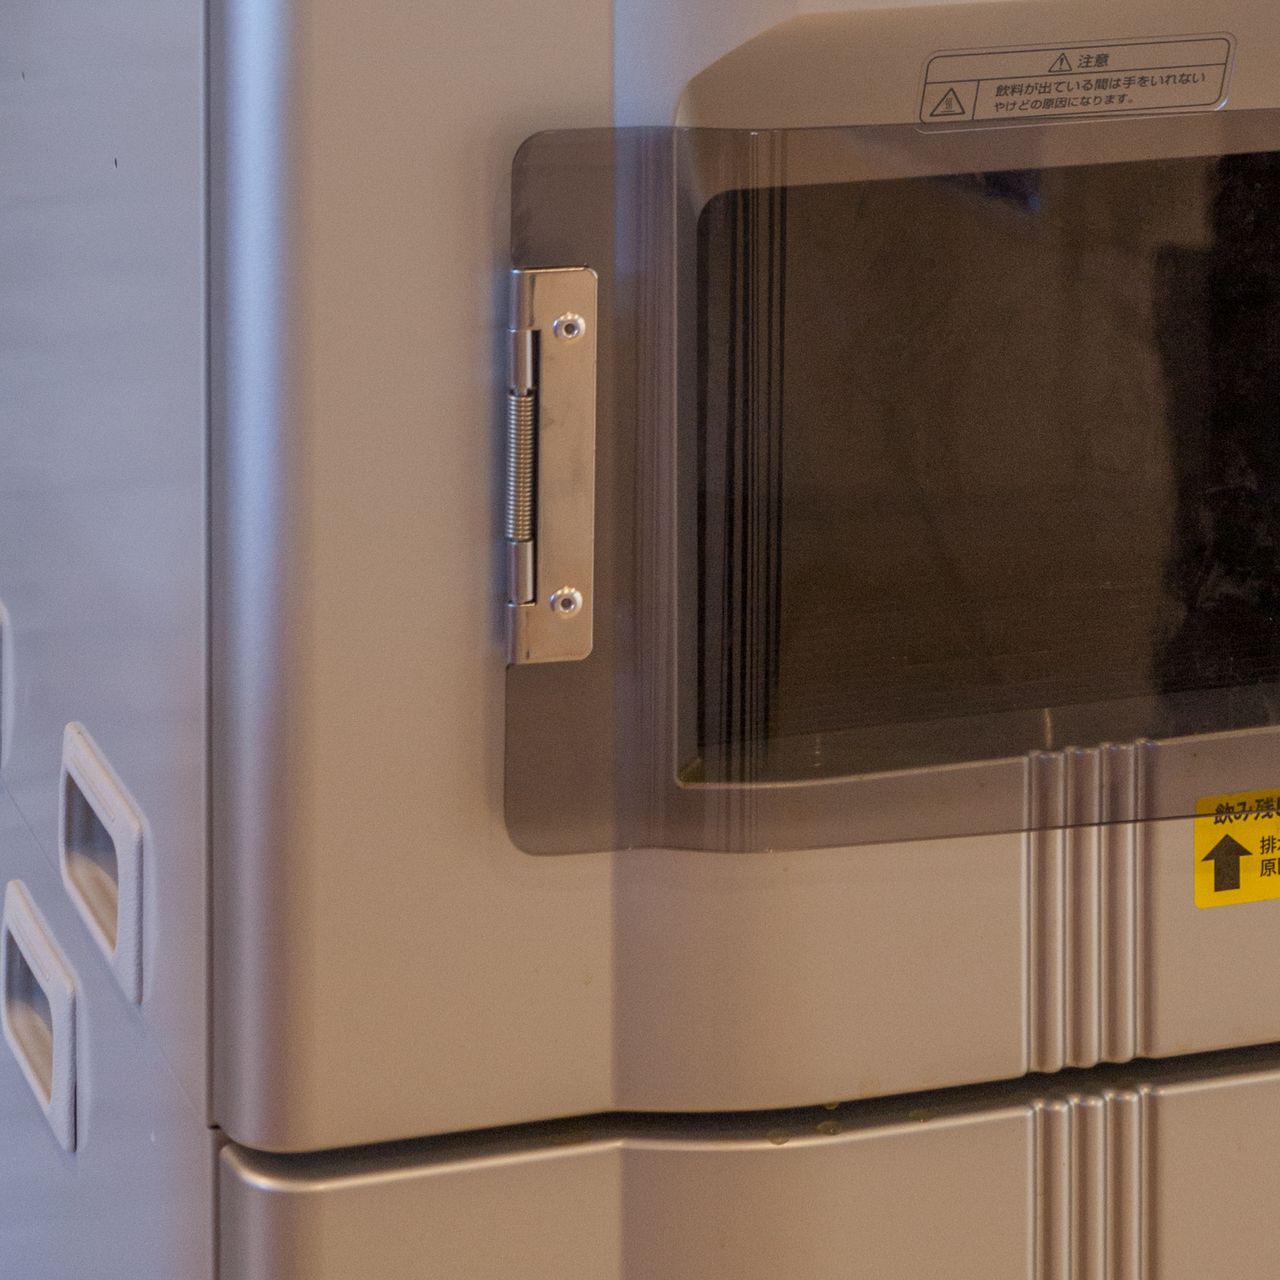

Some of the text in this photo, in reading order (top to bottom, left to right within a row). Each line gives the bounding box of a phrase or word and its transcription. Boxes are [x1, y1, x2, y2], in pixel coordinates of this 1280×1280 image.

[1077, 53, 1109, 69] 注意
[995, 72, 1206, 97] 飲料が出ている間は手をいれない
[994, 93, 1134, 113] やけどの原因になります。
